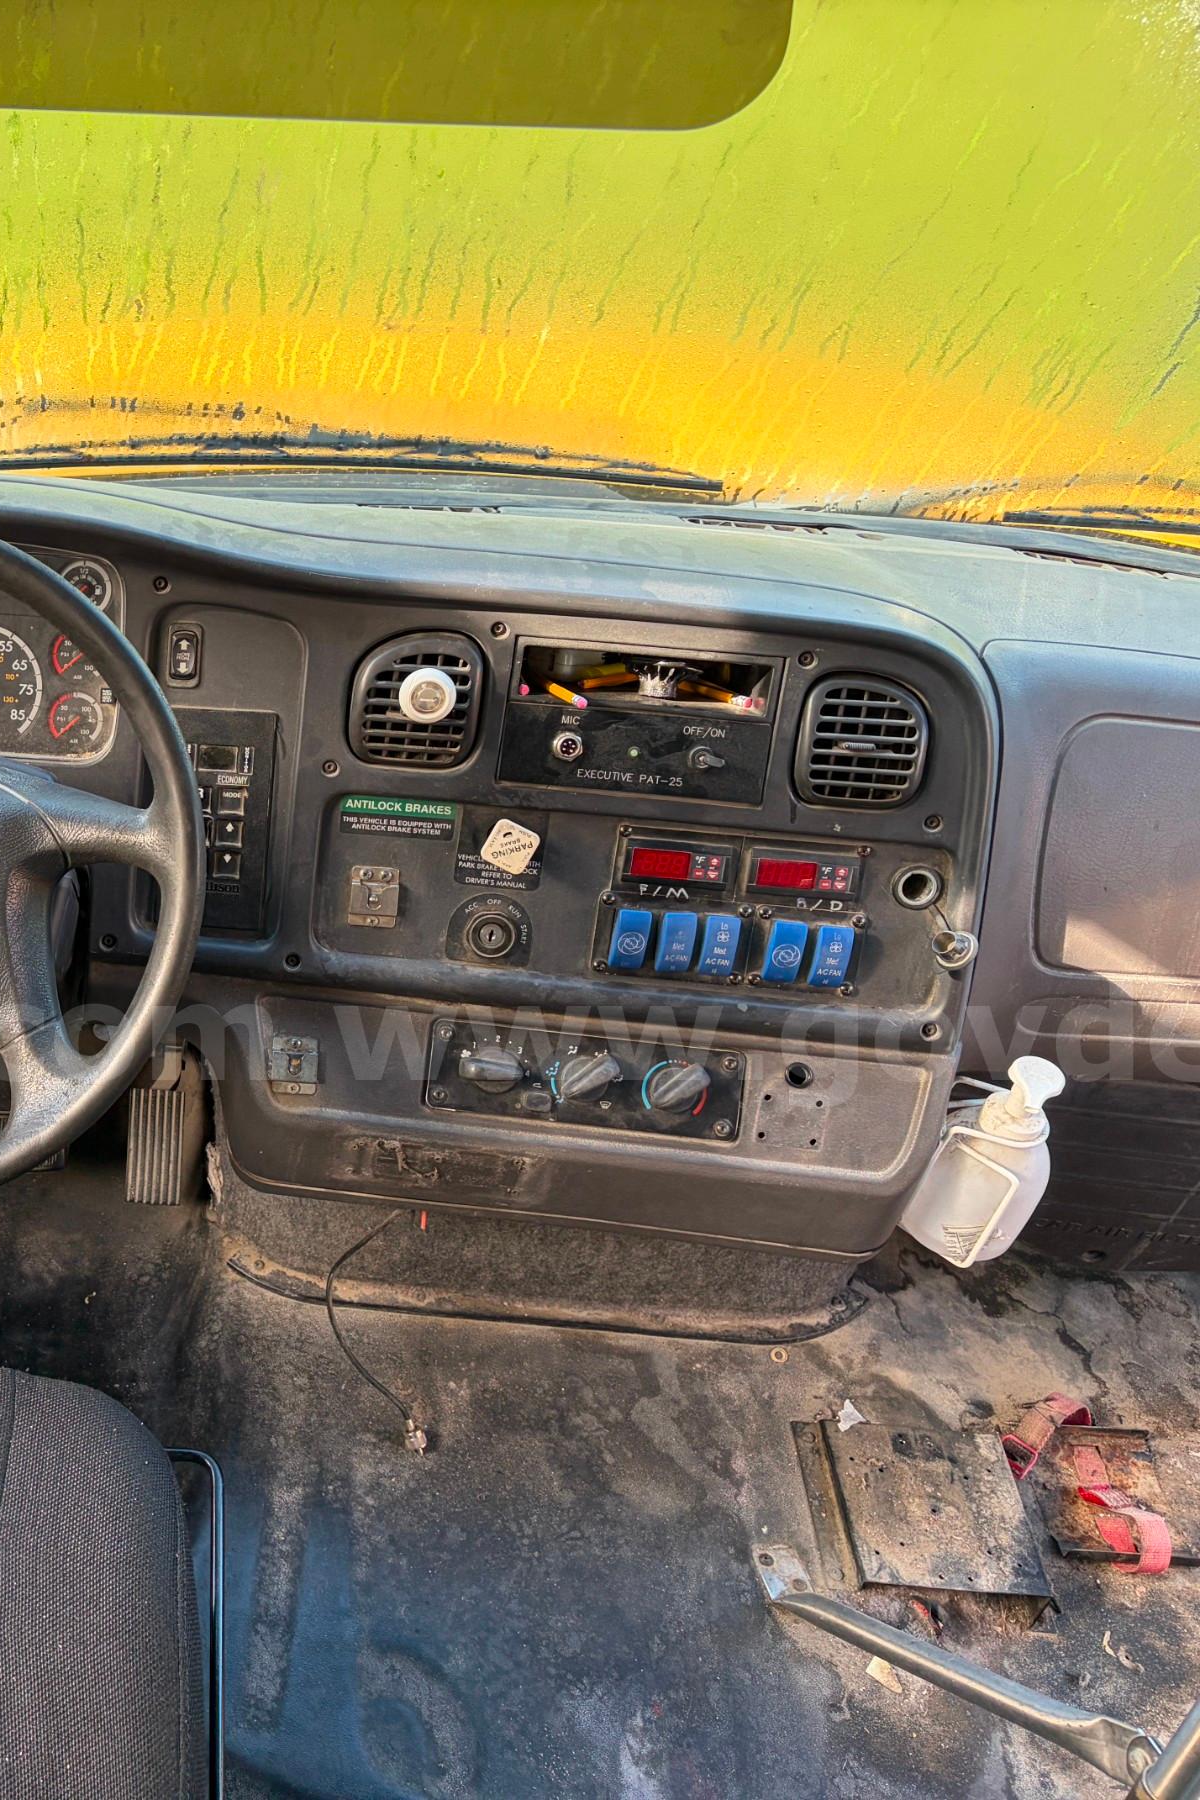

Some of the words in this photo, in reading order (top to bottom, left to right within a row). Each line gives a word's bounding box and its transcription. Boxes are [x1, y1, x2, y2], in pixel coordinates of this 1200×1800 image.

[11, 659, 28, 671] 65
[18, 684, 34, 696] 75
[10, 709, 26, 721] 85
[561, 715, 581, 725] MIC
[683, 726, 726, 739] OFF/ON
[217, 775, 249, 785] ECONOMY
[576, 768, 635, 783] EXECUTIVE
[639, 774, 684, 787] PAT-25
[222, 791, 242, 799] MODE
[345, 798, 402, 812] ANTILOCK
[404, 803, 452, 816] BRAKES
[343, 815, 359, 823] THIS
[360, 817, 388, 826] VEHICLE
[398, 820, 433, 829] EQUIPPED
[351, 823, 386, 832] ANTILOCK
[387, 826, 412, 834] BRAKE
[413, 828, 441, 836] SYSTEM
[491, 840, 534, 860] PARKING
[476, 863, 498, 872] BRAKE
[481, 871, 501, 879] REFER
[465, 877, 495, 886] DRIVER'S
[496, 881, 527, 889] MANUAL
[464, 902, 479, 914] ACC
[508, 904, 522, 919] RUN
[520, 924, 528, 945] START
[713, 946, 727, 955] Med
[717, 958, 730, 967] FAN
[829, 968, 842, 977] FAN
